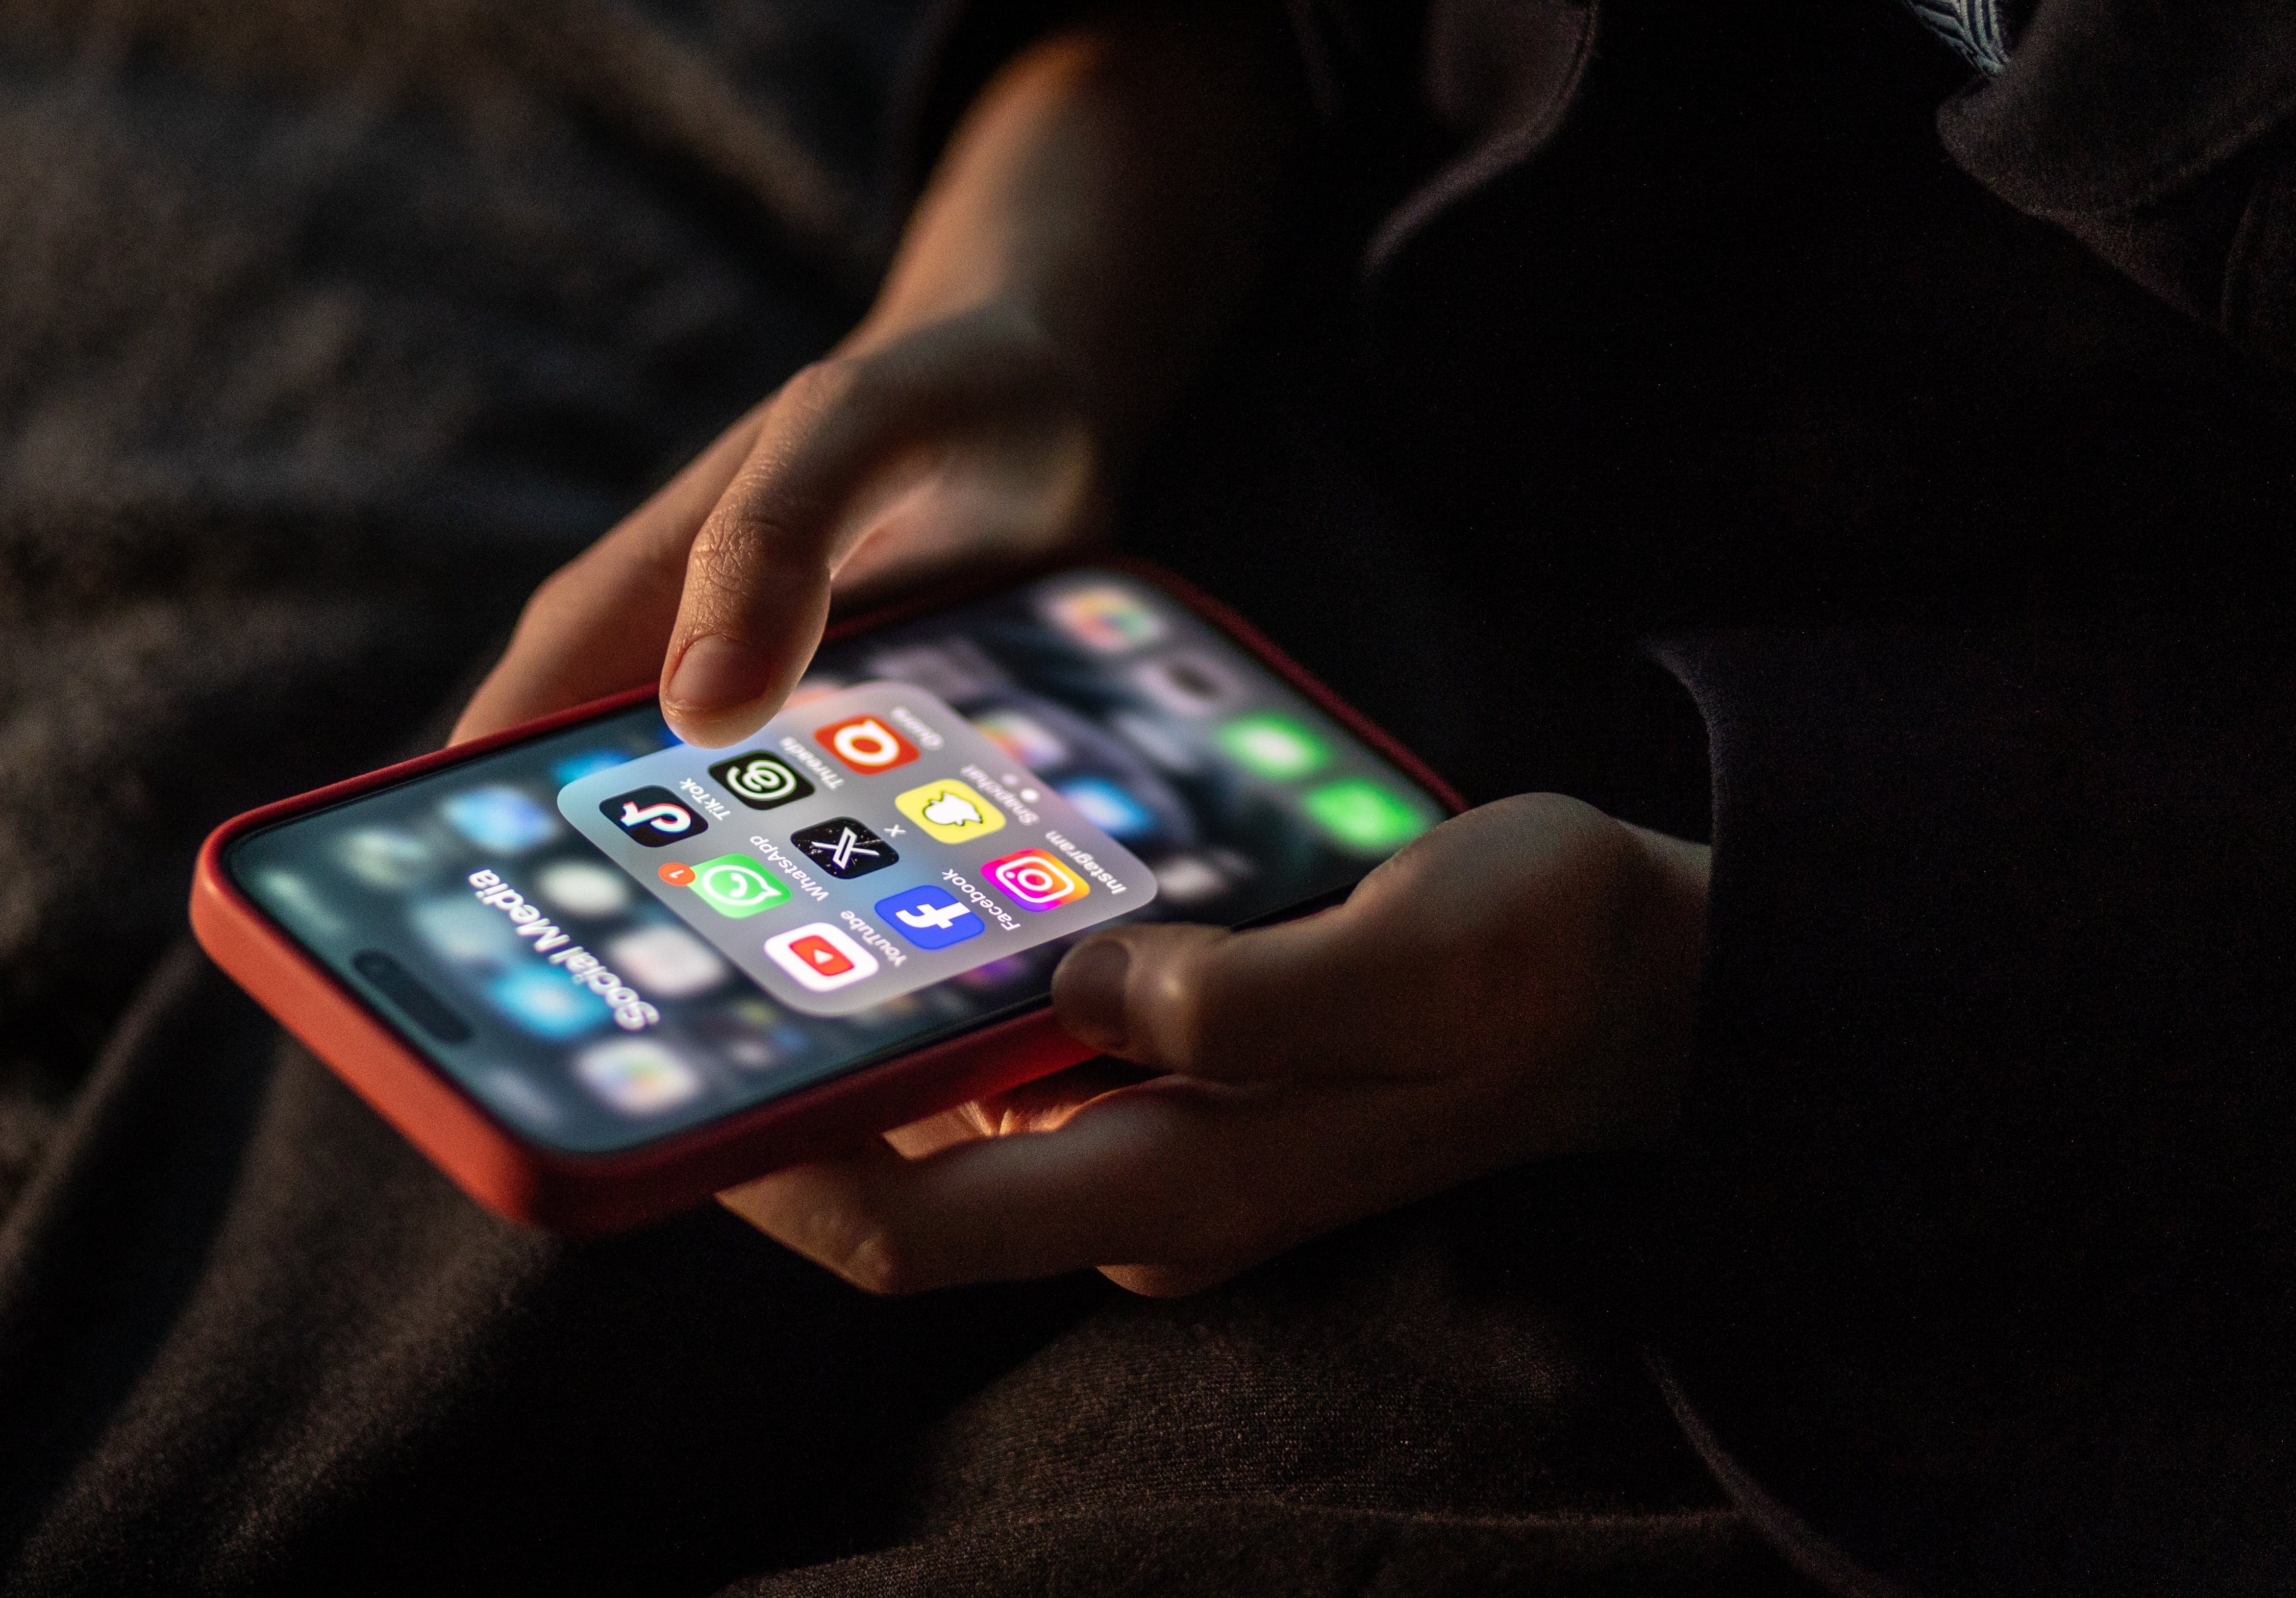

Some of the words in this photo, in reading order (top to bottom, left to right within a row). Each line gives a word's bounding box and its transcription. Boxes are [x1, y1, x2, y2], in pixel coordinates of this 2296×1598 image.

[780, 737, 844, 790] Threads
[679, 778, 731, 821] TikTok
[961, 765, 1039, 824] Snapchat
[884, 824, 907, 838] X
[669, 869, 684, 878] 1
[750, 835, 829, 901] WhatsApp
[1045, 830, 1126, 894] Instagram
[468, 869, 571, 952] Media
[941, 868, 1021, 931] Facebook
[840, 910, 907, 967] YouTube
[548, 946, 660, 1030] Social
